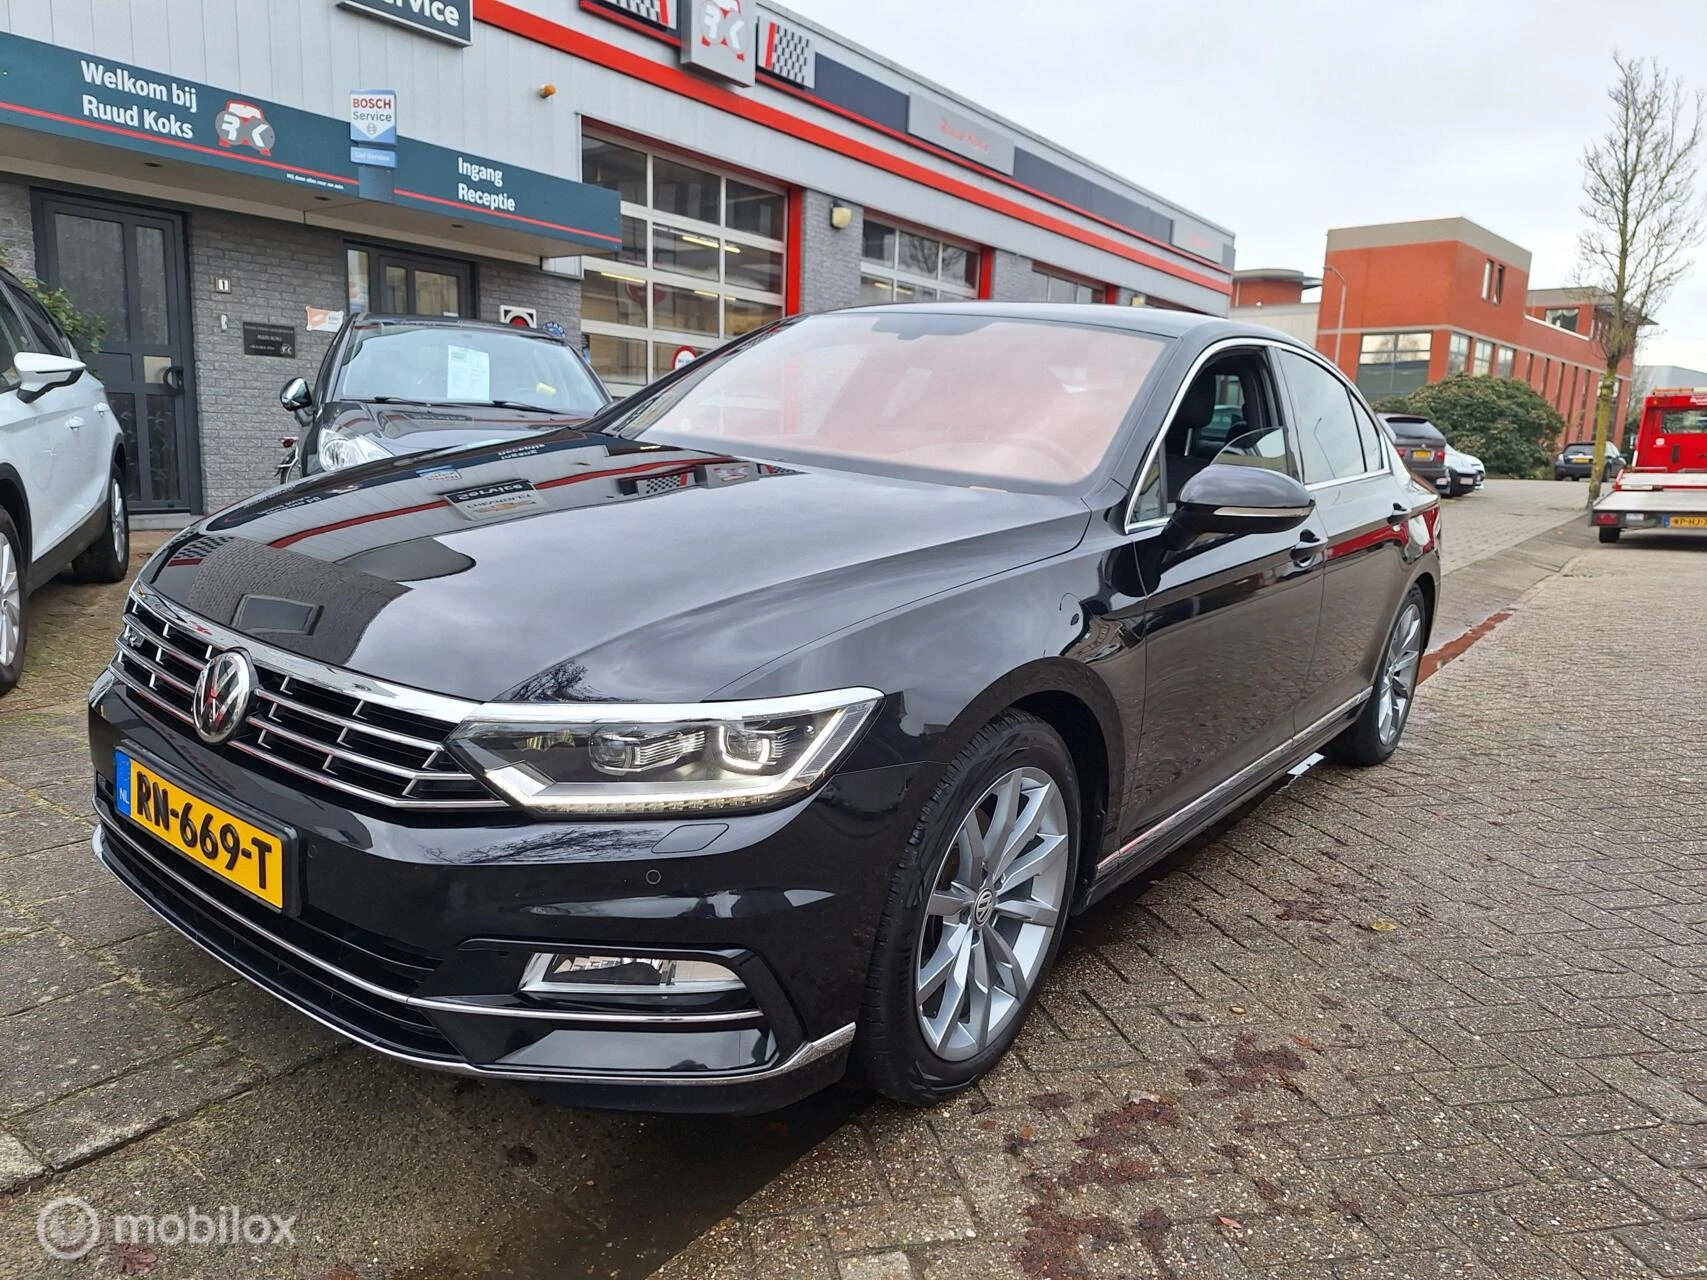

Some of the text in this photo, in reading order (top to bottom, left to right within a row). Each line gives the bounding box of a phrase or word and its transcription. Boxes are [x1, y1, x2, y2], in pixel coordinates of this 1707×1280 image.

[80, 60, 197, 112] Welkom bij
[82, 94, 193, 138] Ruud Koks
[352, 98, 392, 109] BOSCH
[352, 111, 392, 121] Service
[458, 156, 503, 188] Ingang
[458, 182, 516, 211] Receptie
[119, 787, 130, 805] NL
[136, 770, 273, 890] RN-669-T
